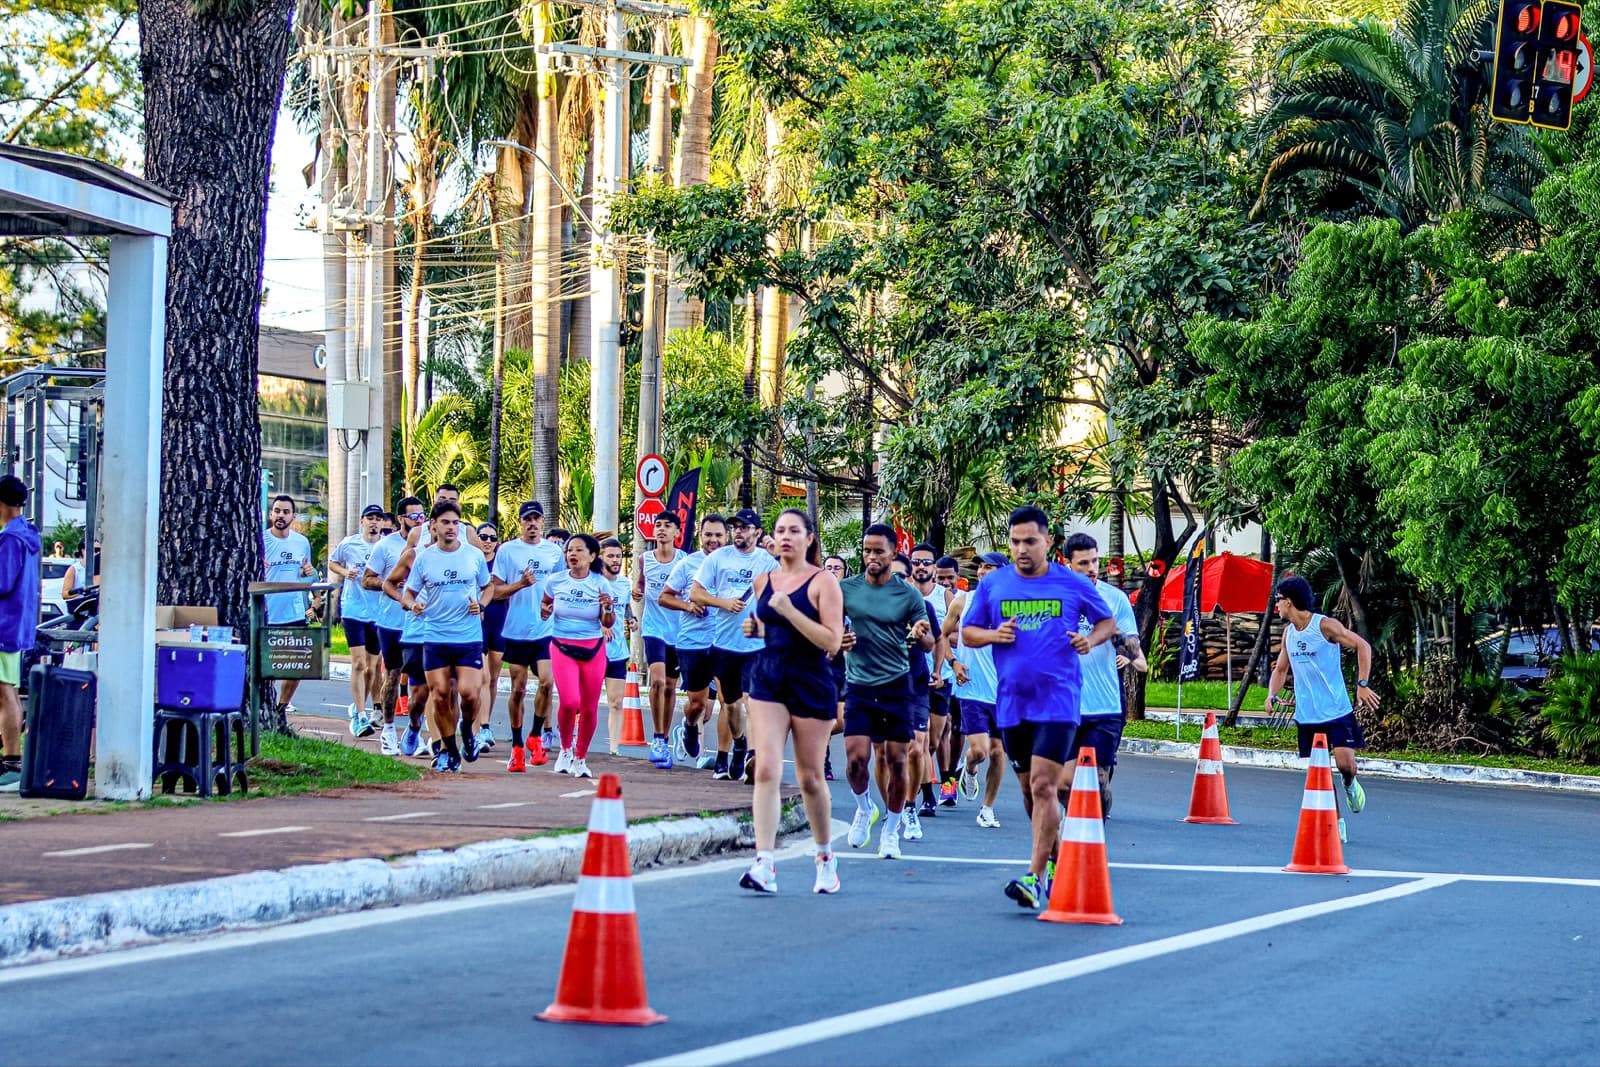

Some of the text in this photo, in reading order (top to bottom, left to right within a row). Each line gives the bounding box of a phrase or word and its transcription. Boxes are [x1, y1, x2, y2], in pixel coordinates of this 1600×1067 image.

[639, 513, 657, 524] PAR
[1001, 600, 1061, 618] HAMMER
[267, 636, 313, 646] Goiânia
[272, 662, 311, 670] COMURG
